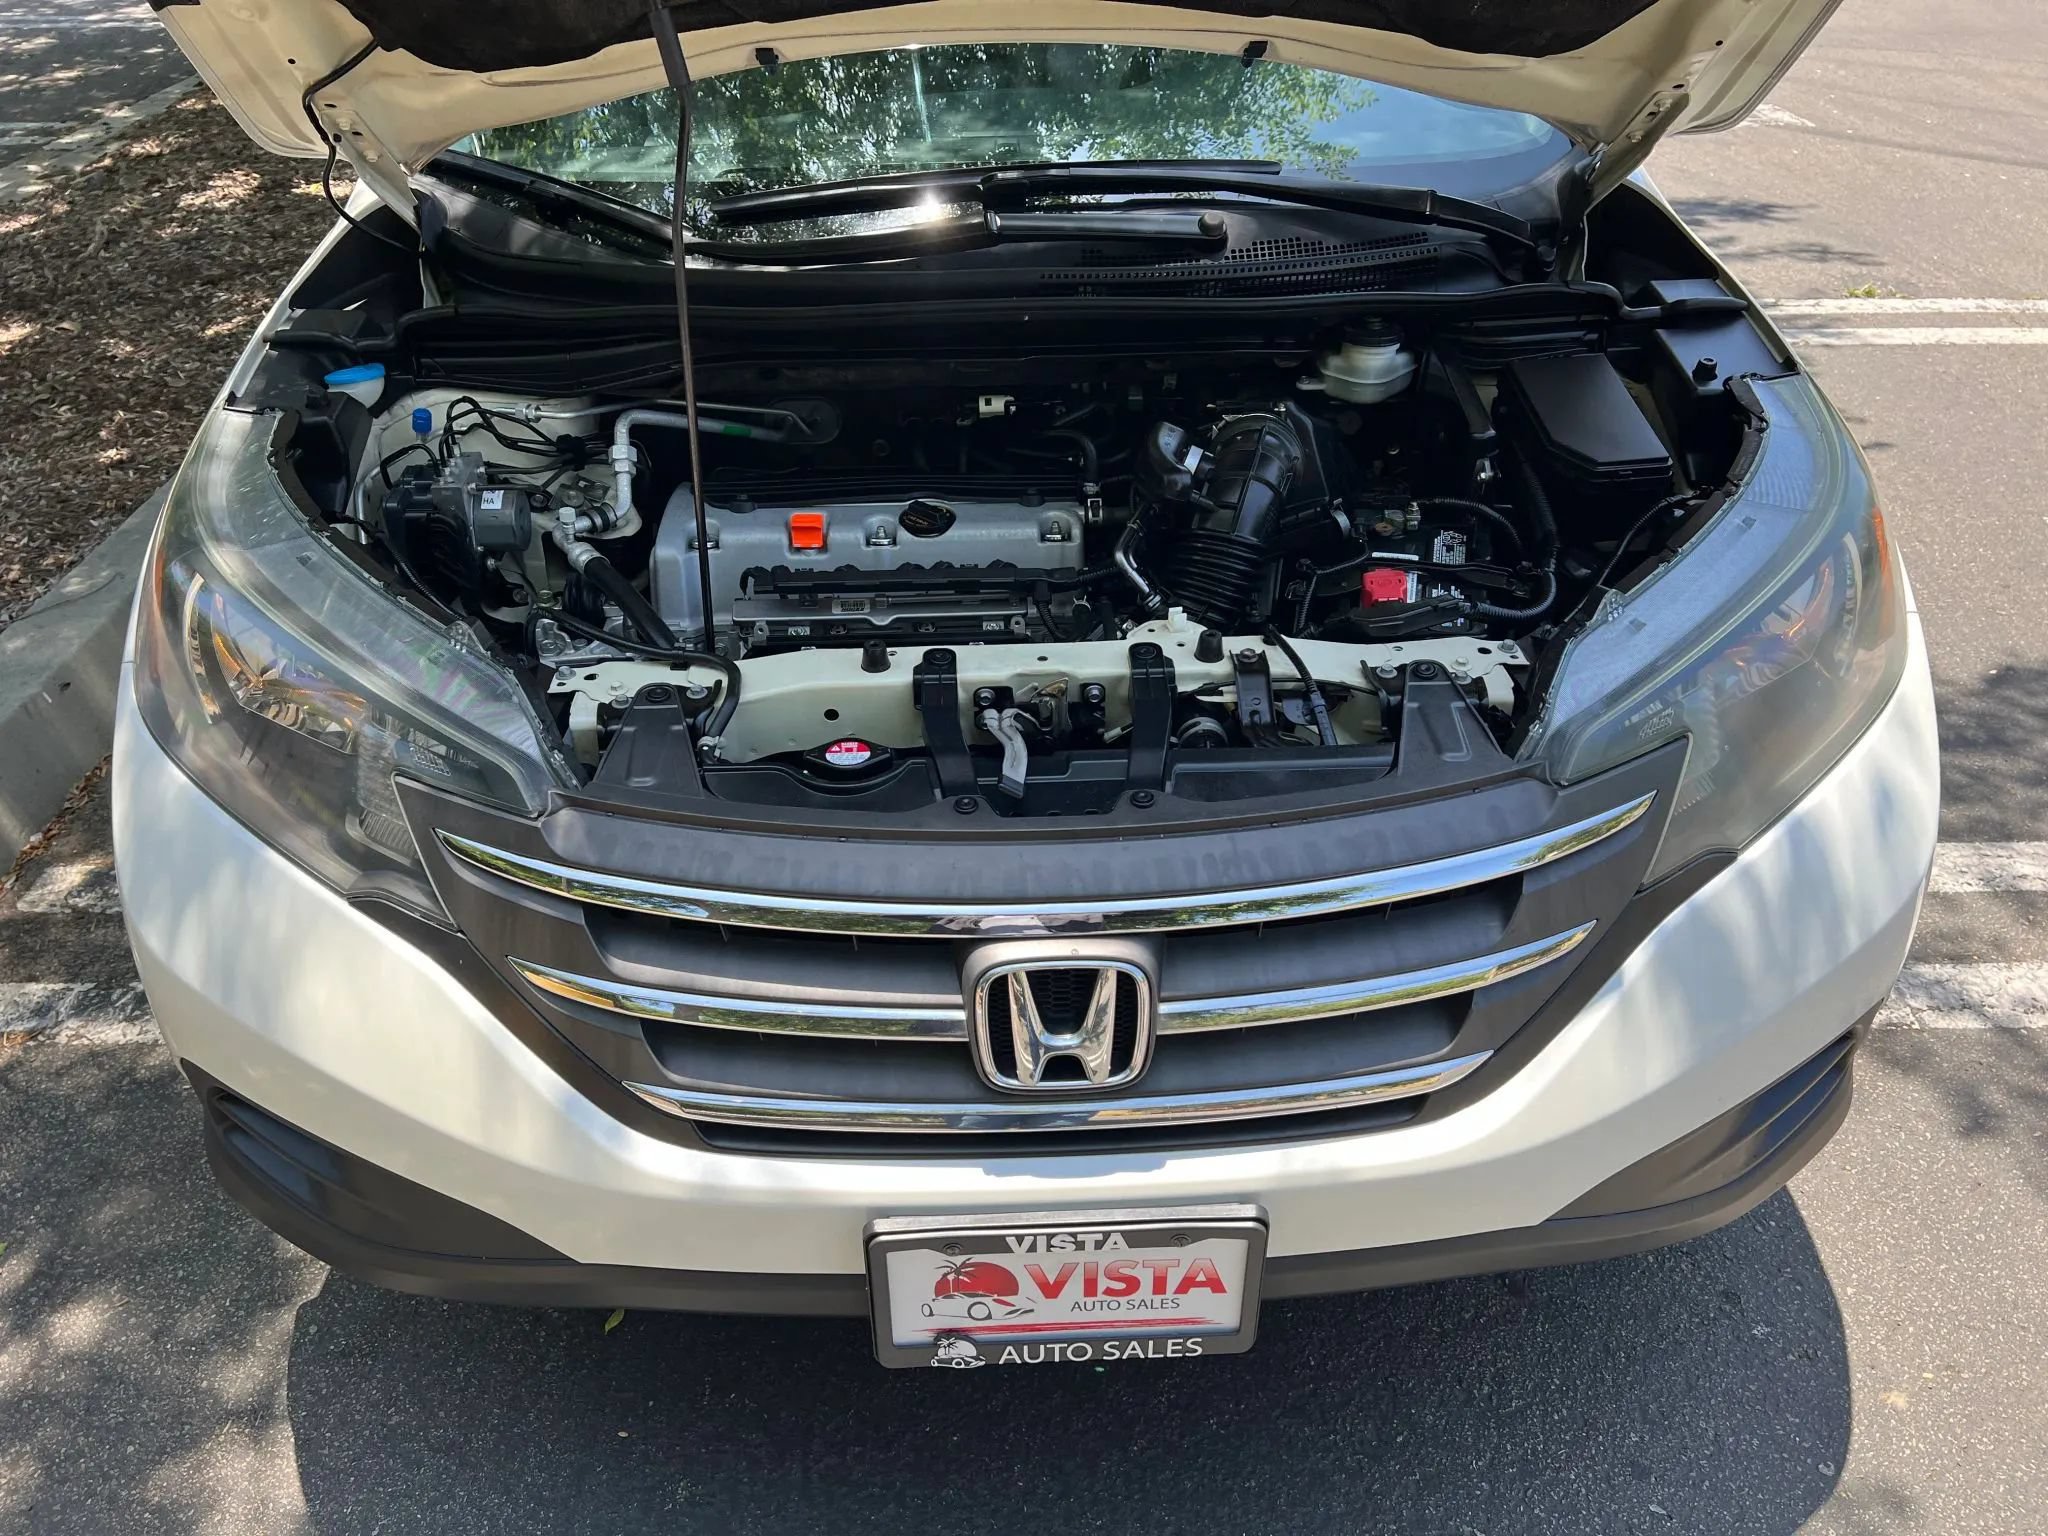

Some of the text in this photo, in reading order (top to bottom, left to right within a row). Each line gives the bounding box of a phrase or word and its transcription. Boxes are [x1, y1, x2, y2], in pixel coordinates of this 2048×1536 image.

[1005, 1232, 1129, 1254] VISTA
[1024, 1258, 1227, 1299] VISTA
[1070, 1297, 1180, 1313] AUTO SALES
[999, 1338, 1203, 1365] AUTO SALES
